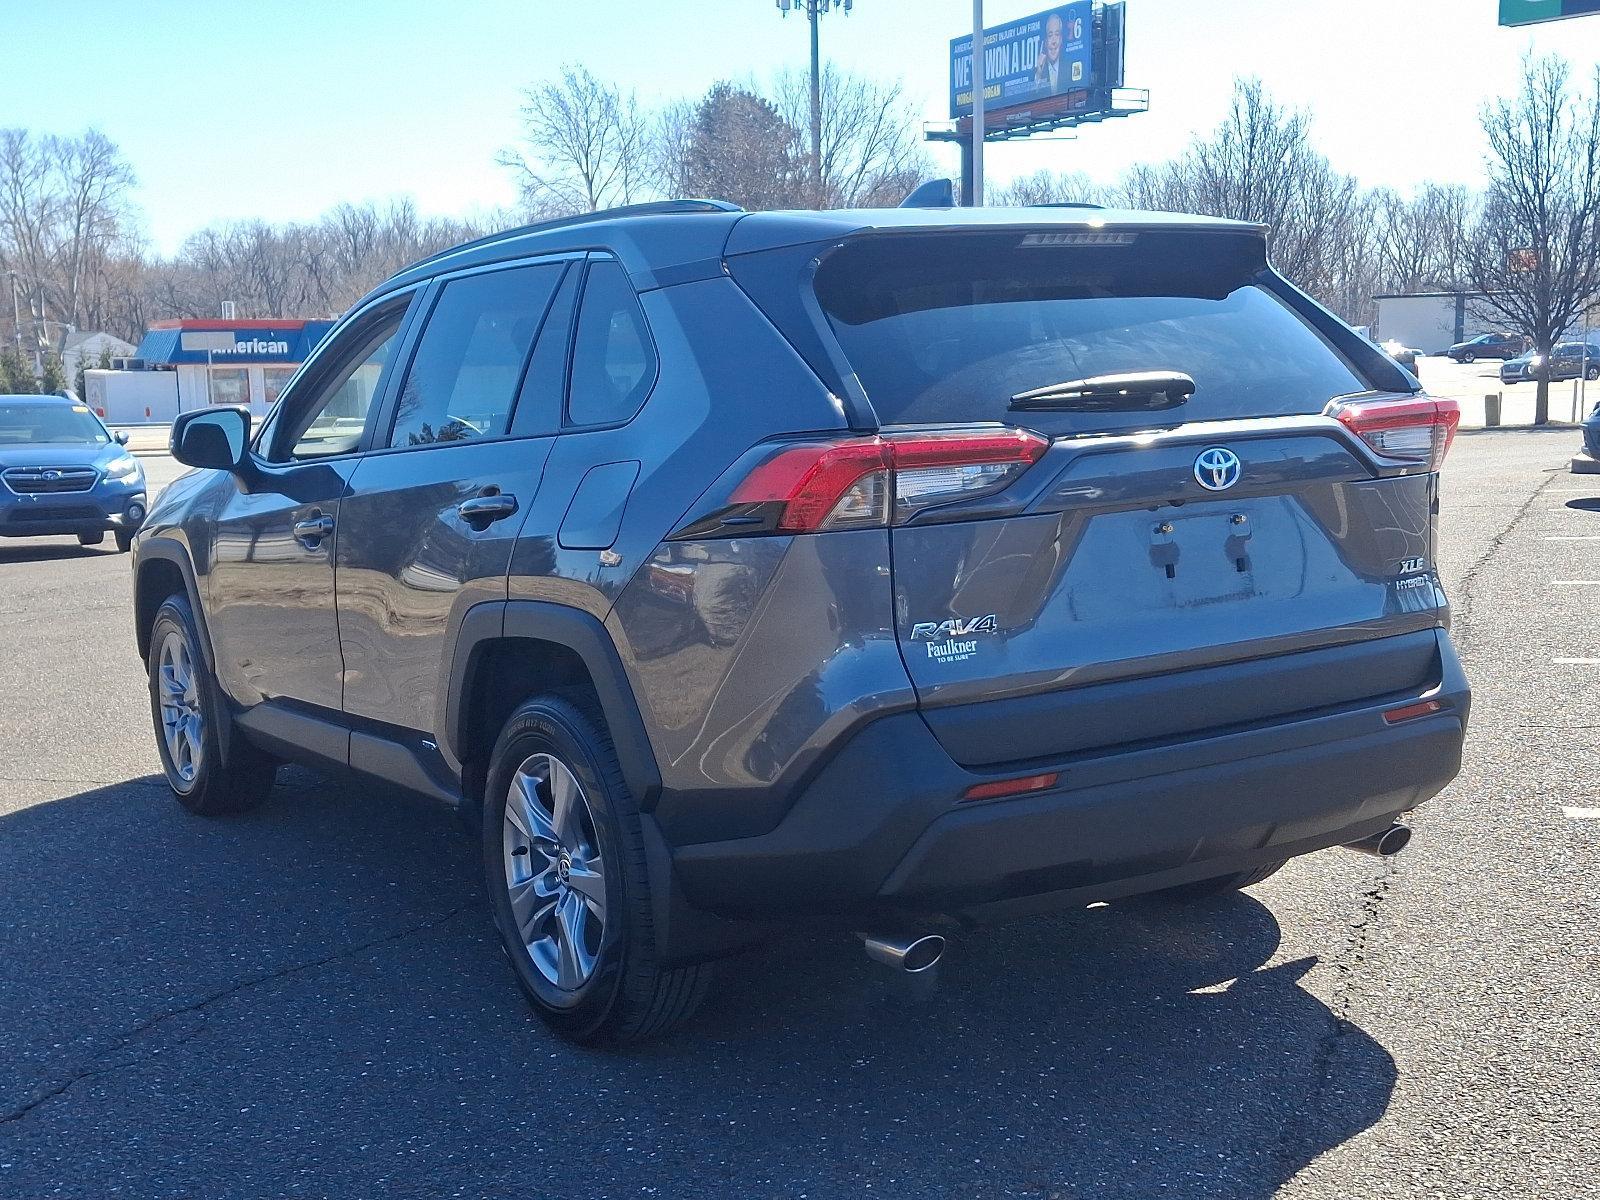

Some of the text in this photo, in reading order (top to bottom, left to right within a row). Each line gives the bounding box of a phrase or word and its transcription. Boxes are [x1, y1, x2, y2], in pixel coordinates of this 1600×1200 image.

[999, 28, 1016, 41] INJURY
[1016, 25, 1028, 36] LAW
[1027, 20, 1040, 32] FIRM
[954, 54, 973, 89] WE'
[985, 43, 1009, 80] WON
[1011, 41, 1019, 74] A
[1021, 35, 1040, 71] LOT
[1399, 557, 1424, 574] XLE
[1396, 576, 1426, 590] HYBRID
[910, 614, 998, 640] RAV4
[926, 639, 977, 658] Faulkner
[937, 656, 946, 664] TO
[954, 653, 969, 661] SURE
